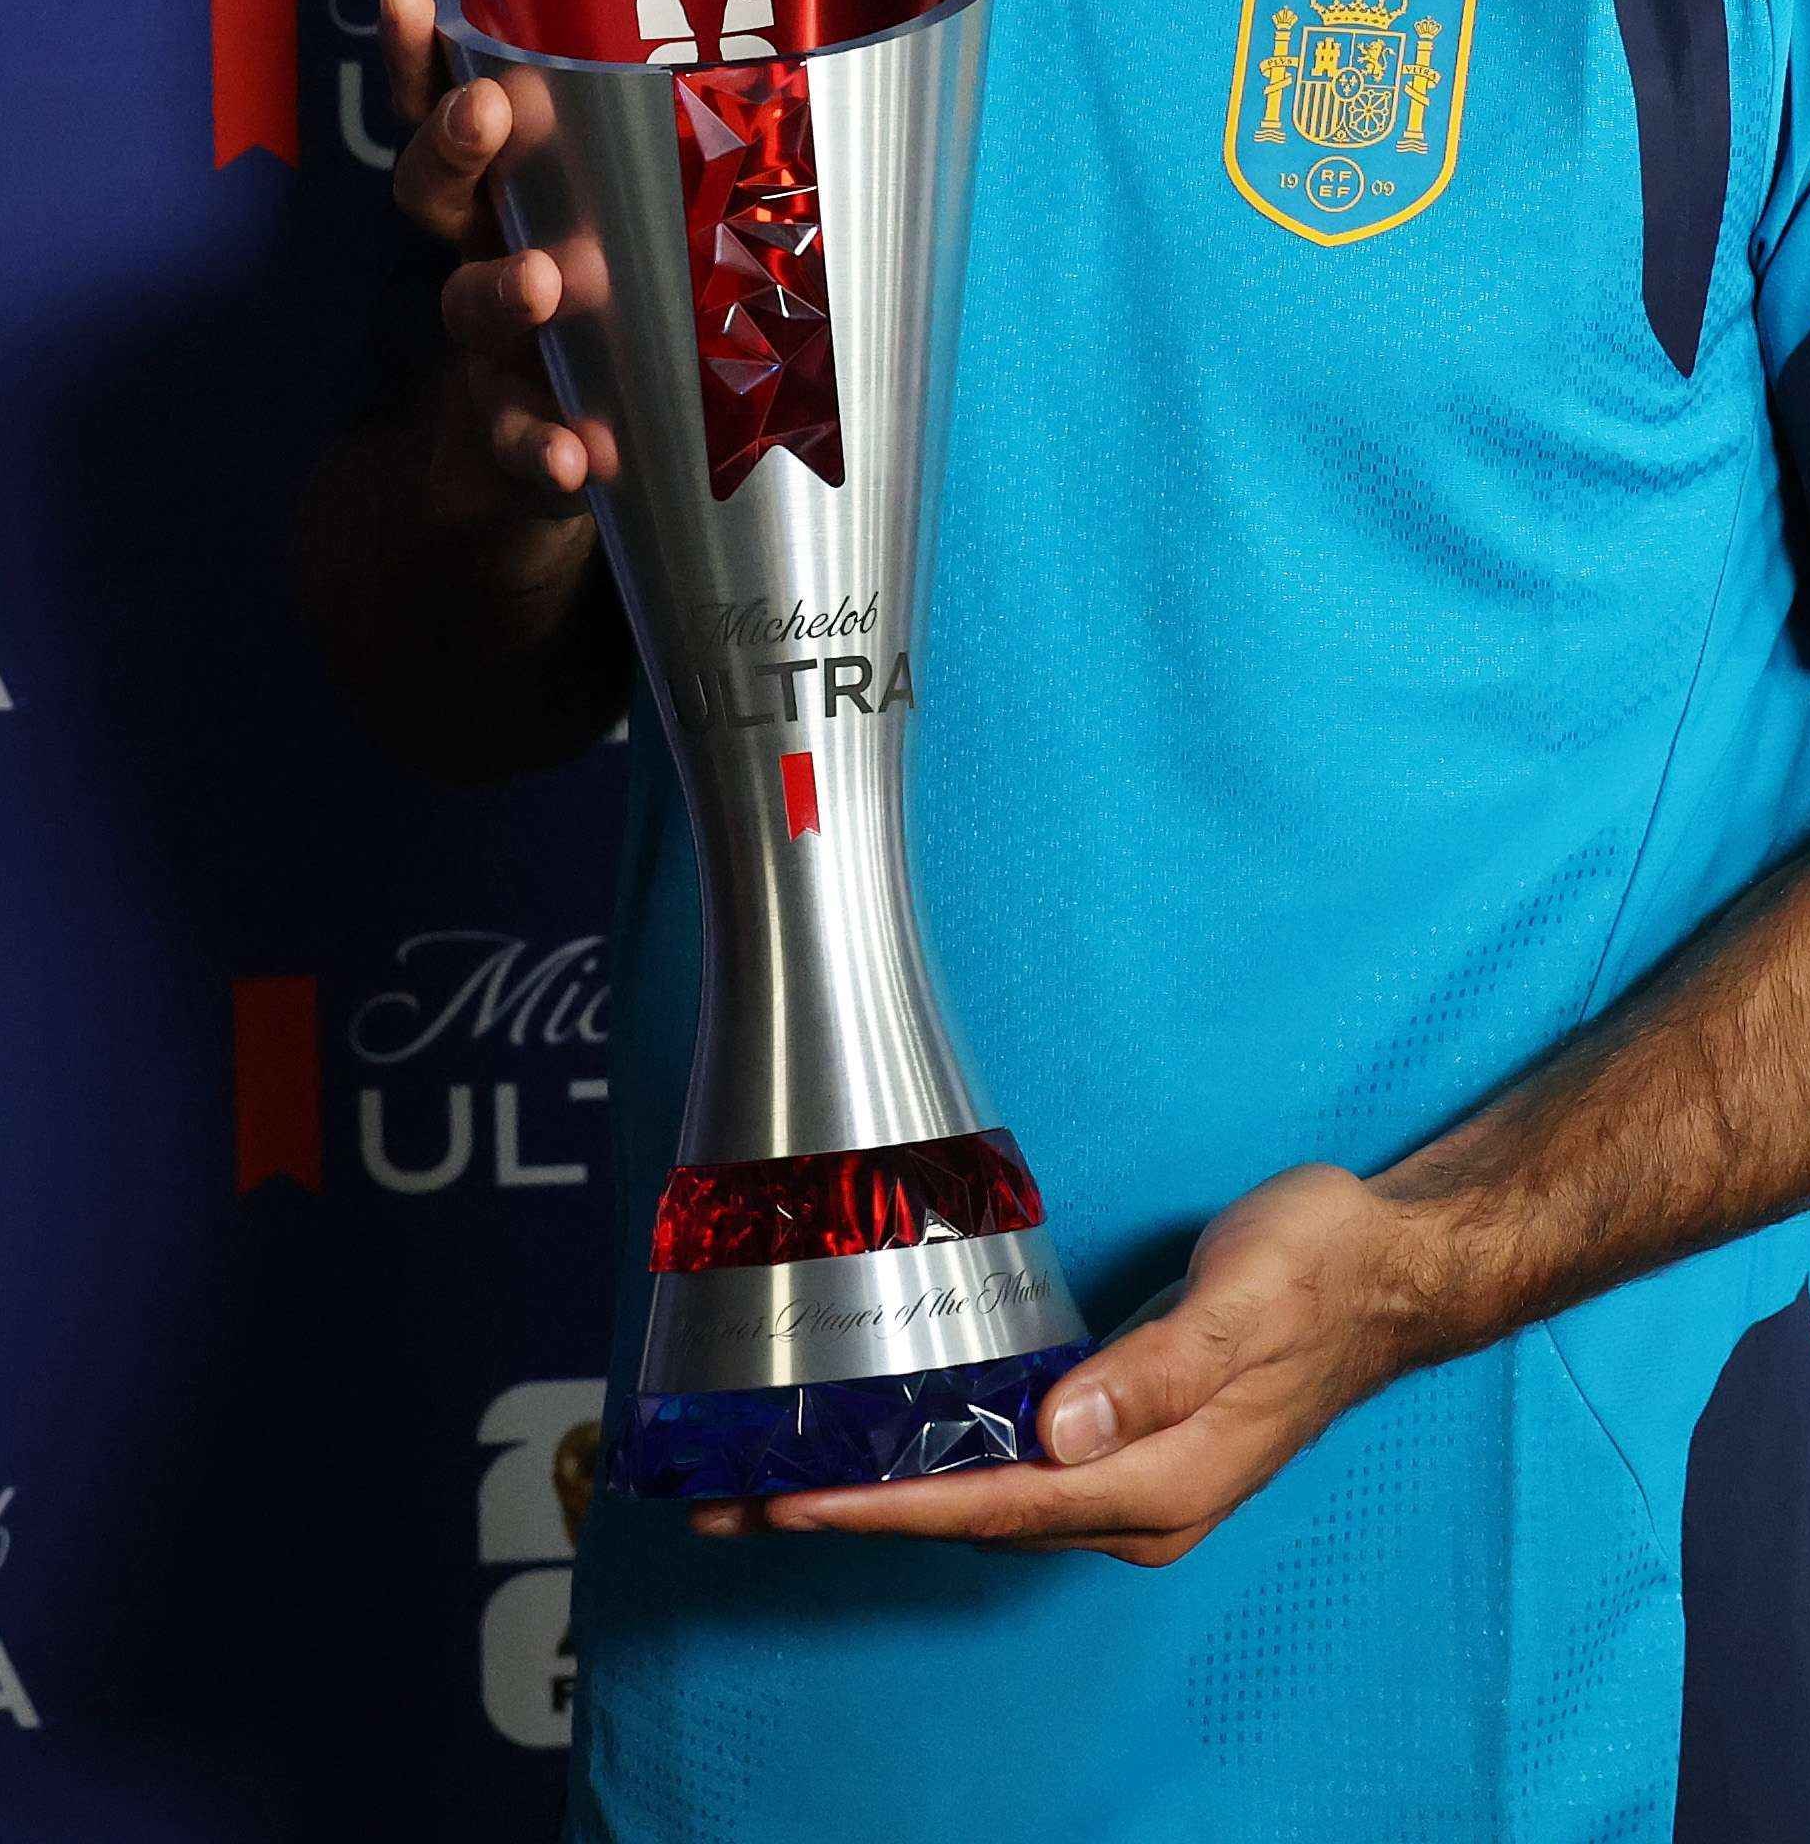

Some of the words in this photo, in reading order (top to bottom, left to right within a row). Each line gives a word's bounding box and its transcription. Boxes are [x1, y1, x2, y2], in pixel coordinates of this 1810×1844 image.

[698, 590, 879, 650] Michelob
[894, 1286, 942, 1333] of
[928, 1286, 970, 1318] the
